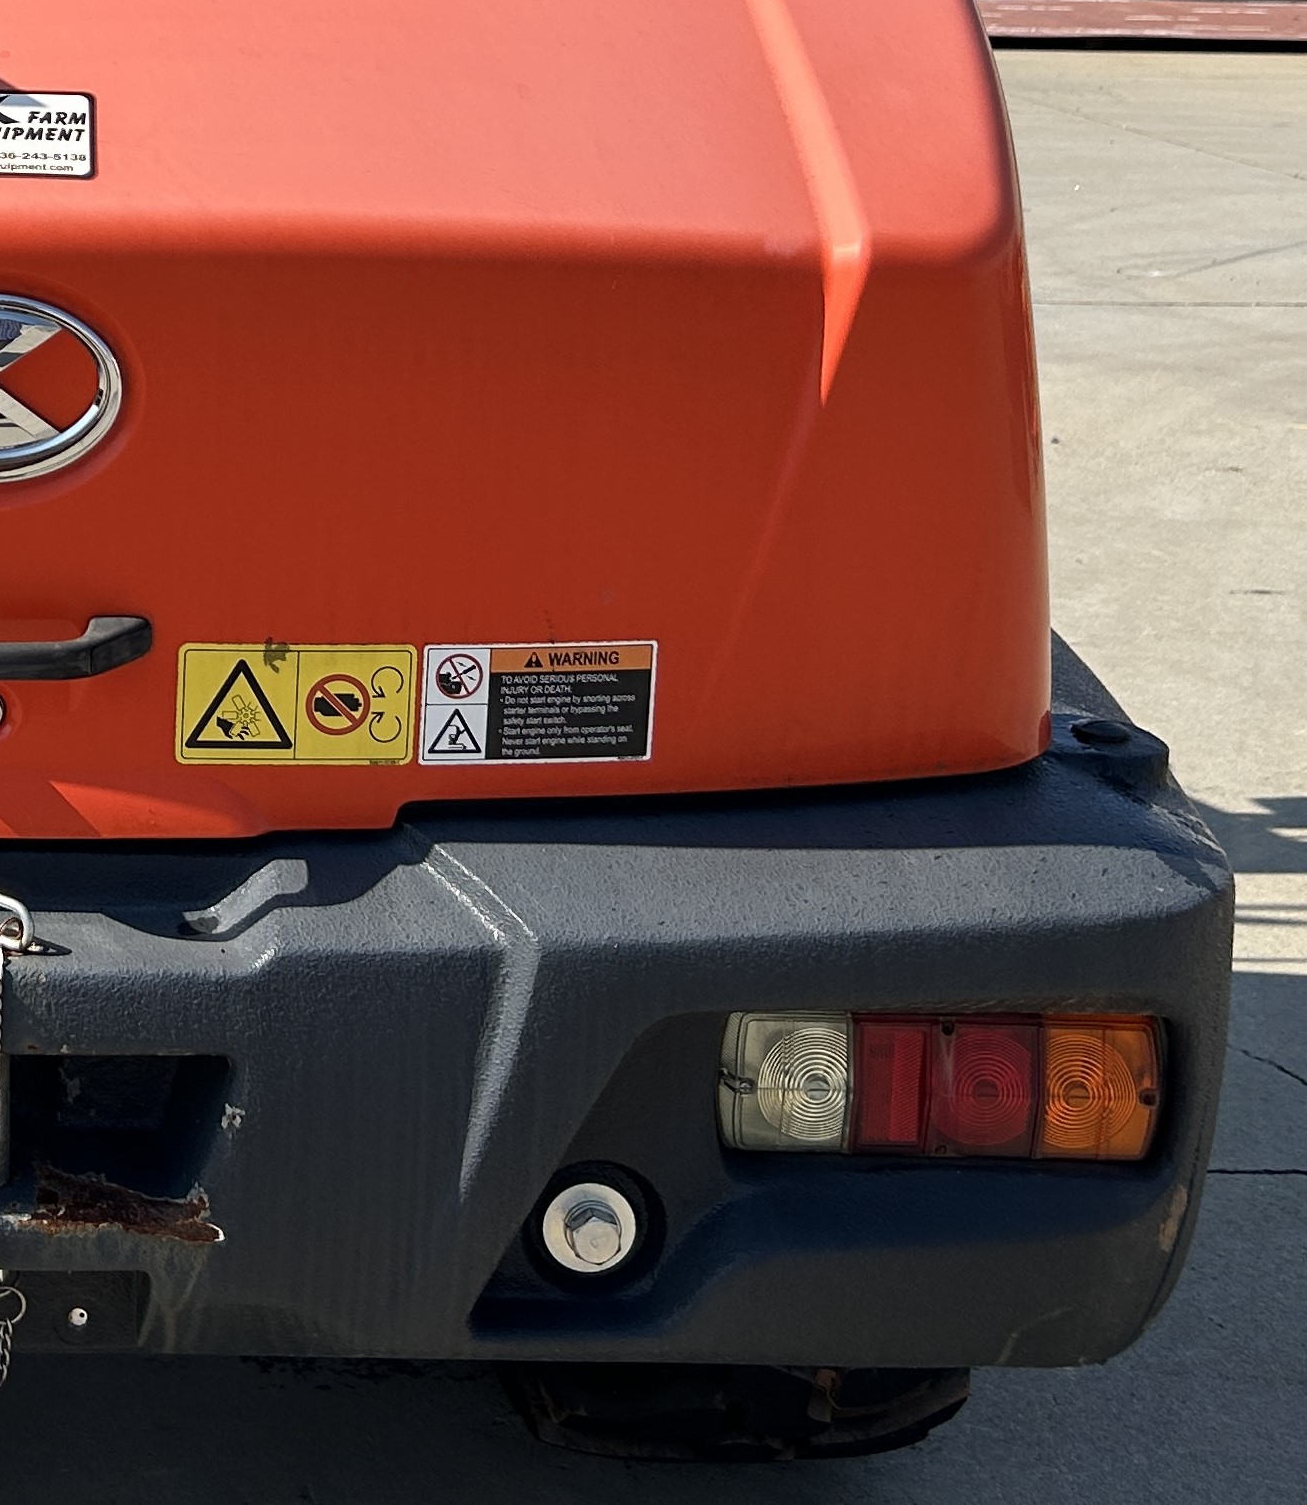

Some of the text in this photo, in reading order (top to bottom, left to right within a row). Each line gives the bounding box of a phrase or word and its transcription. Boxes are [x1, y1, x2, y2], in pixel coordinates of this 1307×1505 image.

[28, 111, 86, 125] FARM
[549, 651, 620, 666] WARNING
[501, 674, 618, 684] TO AVOID SERIOUS PERSONAL
[500, 686, 529, 694] INJURY
[530, 686, 543, 694] OR
[505, 696, 515, 704] Do
[517, 696, 528, 704] not
[547, 695, 571, 705] engine
[572, 695, 581, 704] by
[503, 727, 520, 735] Start
